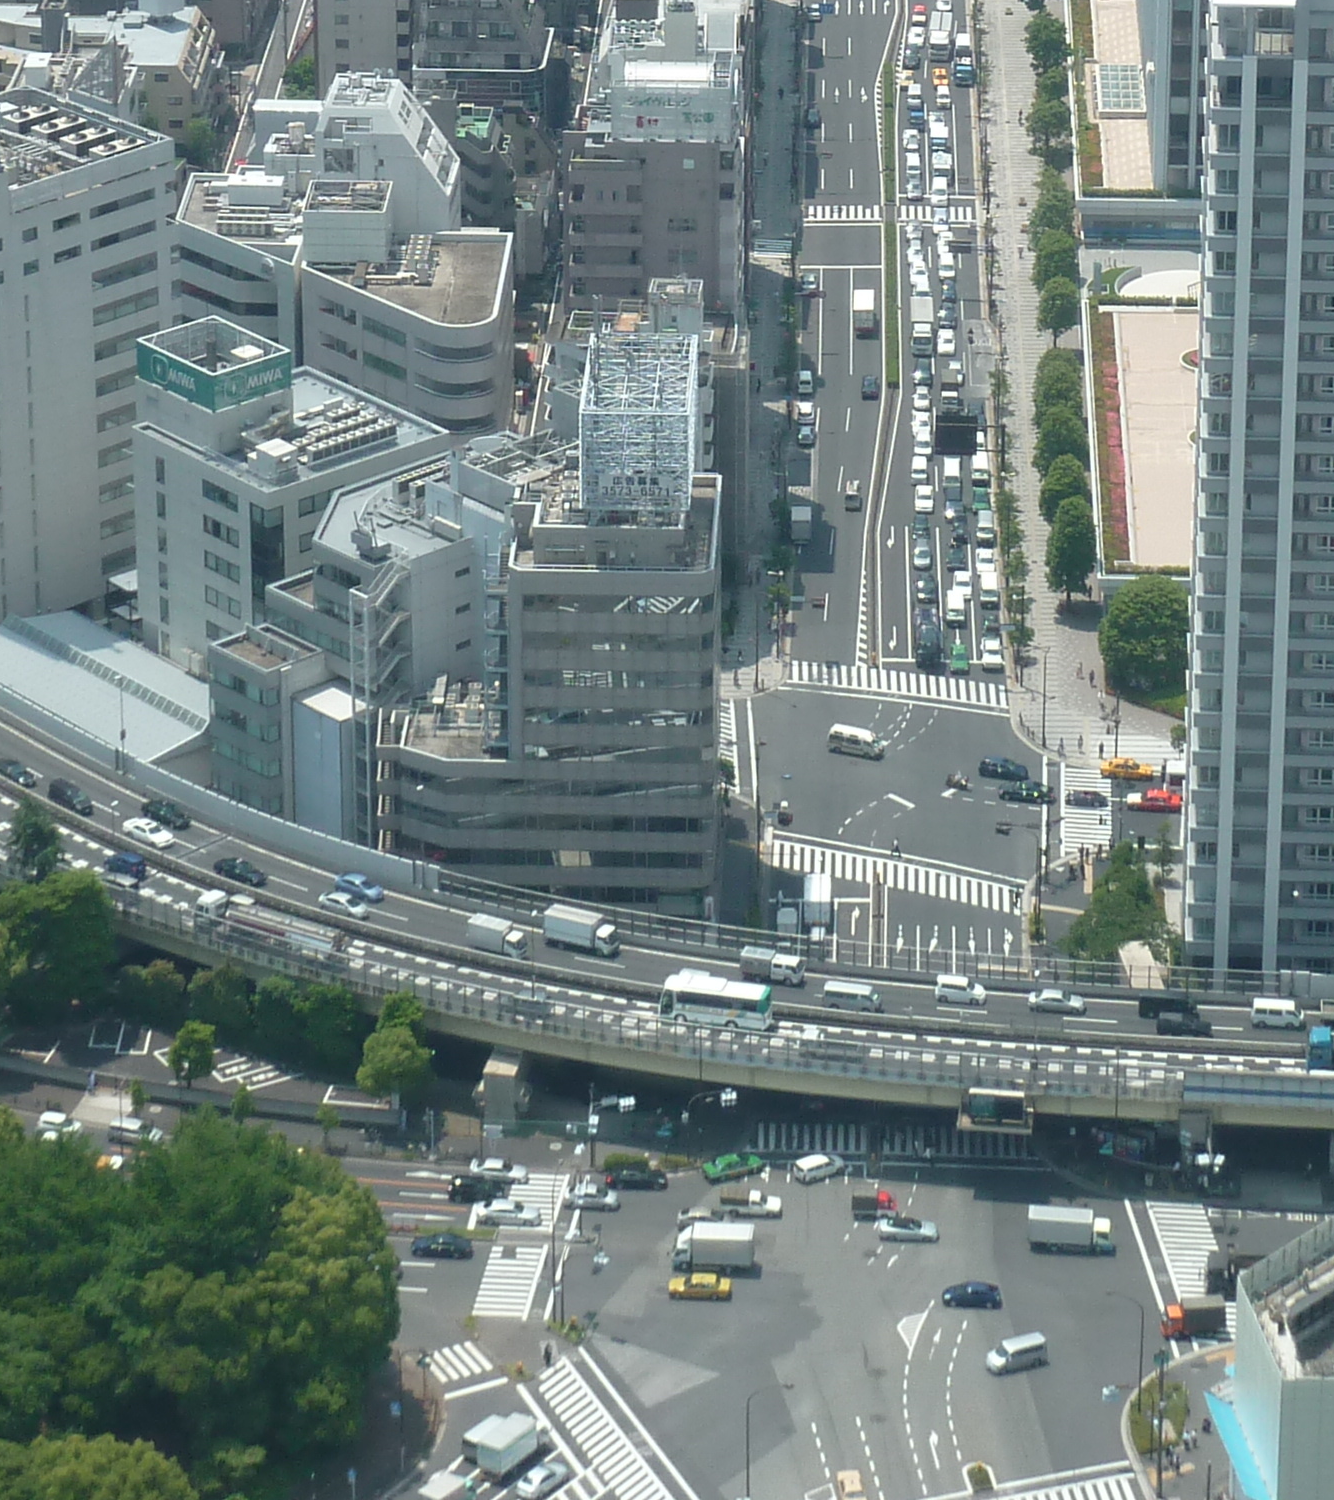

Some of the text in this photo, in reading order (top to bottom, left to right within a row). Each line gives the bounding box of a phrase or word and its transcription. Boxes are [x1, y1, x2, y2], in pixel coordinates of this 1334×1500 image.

[168, 367, 196, 391] MIWA
[247, 368, 283, 389] MIWA
[602, 486, 670, 497] 3573-6571
